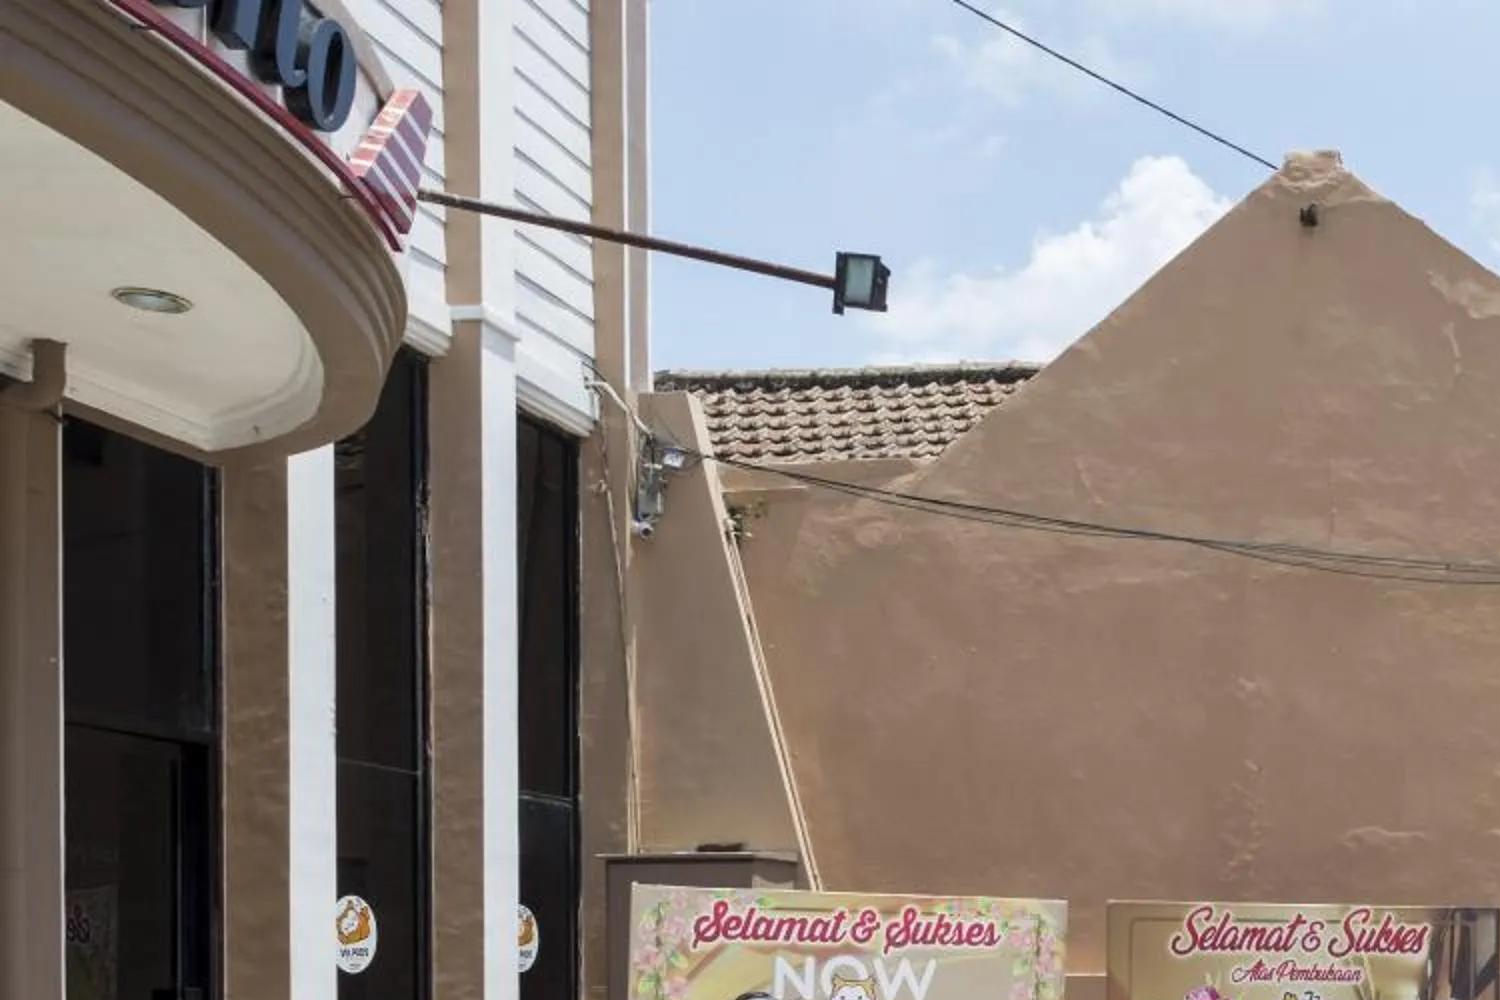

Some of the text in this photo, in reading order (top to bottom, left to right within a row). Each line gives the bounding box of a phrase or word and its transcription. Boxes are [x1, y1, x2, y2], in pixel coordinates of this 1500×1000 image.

[693, 900, 1000, 953] Selamat & Sukses
[1171, 906, 1306, 955] Selamat
[1328, 908, 1428, 957] Sukses
[1232, 959, 1361, 982] Atas Pembukaan
